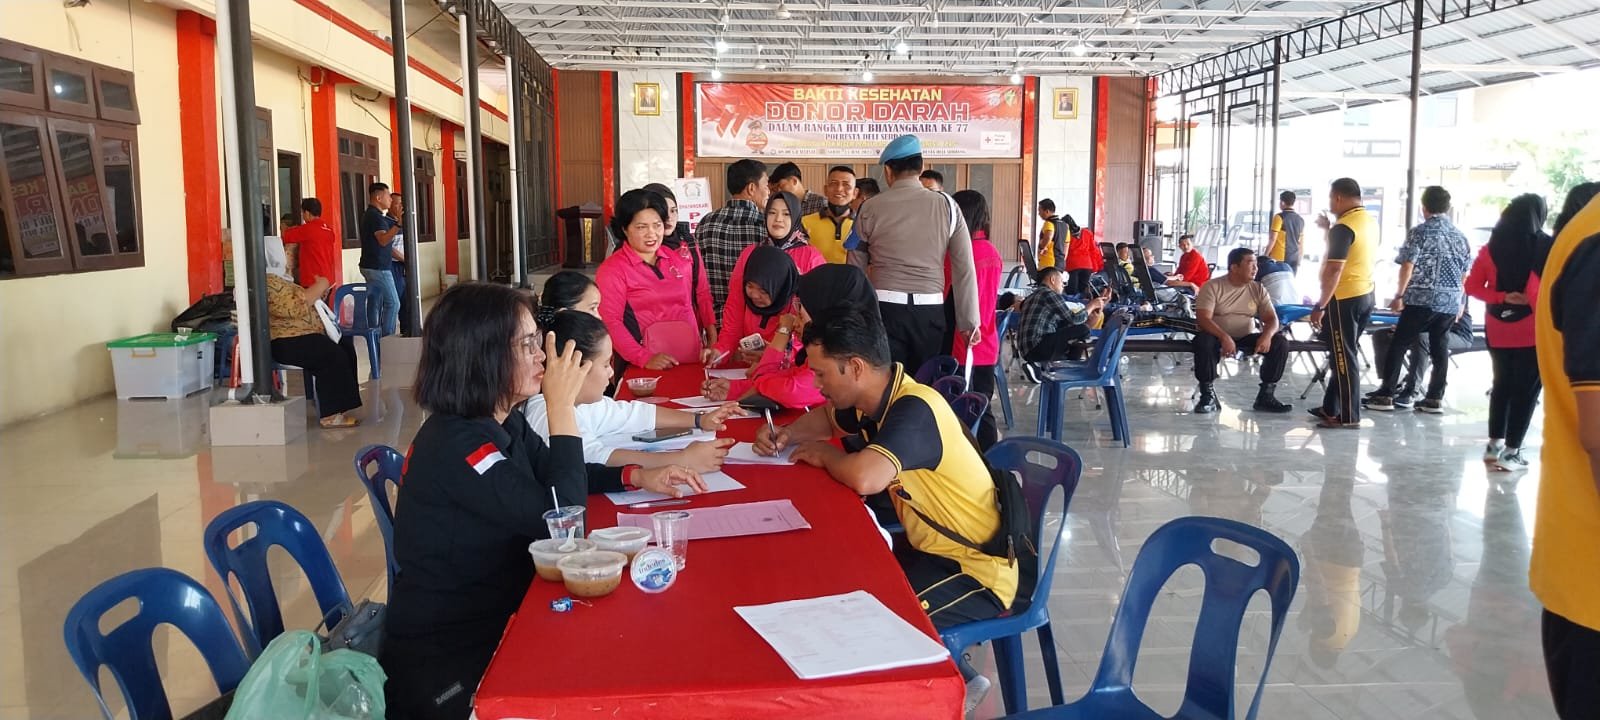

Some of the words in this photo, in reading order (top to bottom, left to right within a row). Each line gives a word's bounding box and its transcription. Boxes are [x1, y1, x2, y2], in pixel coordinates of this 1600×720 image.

[793, 88, 843, 101] BAKTI
[847, 88, 942, 101] KESEHATAN
[765, 101, 866, 122] DONOR
[873, 102, 970, 123] DARAH
[768, 123, 800, 133] DALAM
[803, 123, 843, 133] RANGKA
[846, 123, 865, 133] HUT
[868, 123, 938, 133] BHAYANGKARA
[941, 123, 953, 133] KE
[956, 123, 969, 133] 77
[825, 133, 860, 141] POLRESTA
[863, 133, 879, 141] DELI
